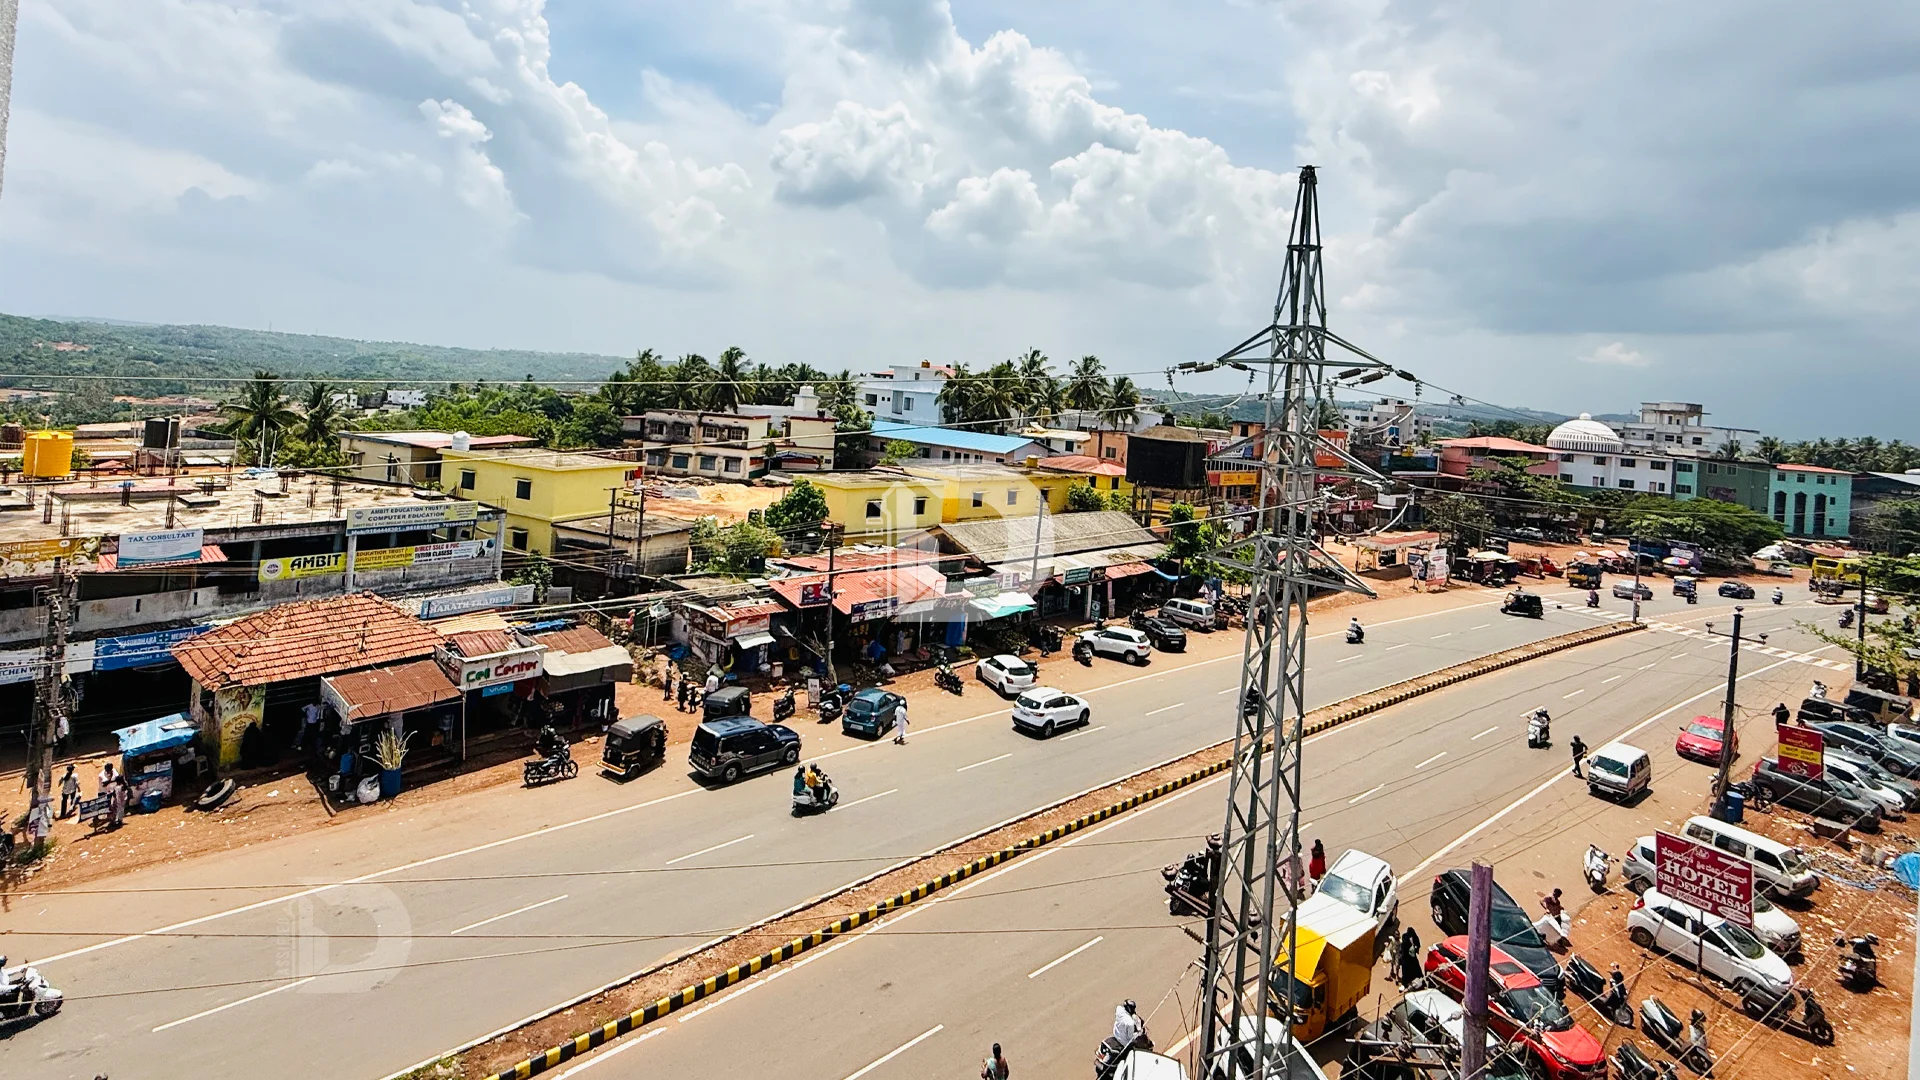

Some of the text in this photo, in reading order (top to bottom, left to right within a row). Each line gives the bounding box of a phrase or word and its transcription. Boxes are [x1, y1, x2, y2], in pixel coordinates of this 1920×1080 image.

[390, 506, 423, 514] EDUCATION
[368, 514, 407, 522] COMPUTER
[146, 532, 195, 541] CONSULTANT
[356, 549, 387, 557] EDUCATION
[290, 553, 342, 571] AMBIT
[466, 667, 491, 683] Cell
[494, 660, 539, 677] Center
[489, 685, 508, 693] vivo
[1664, 859, 1743, 900] HOTEL
[1658, 871, 1749, 913] SRI DEVI PRASAD
